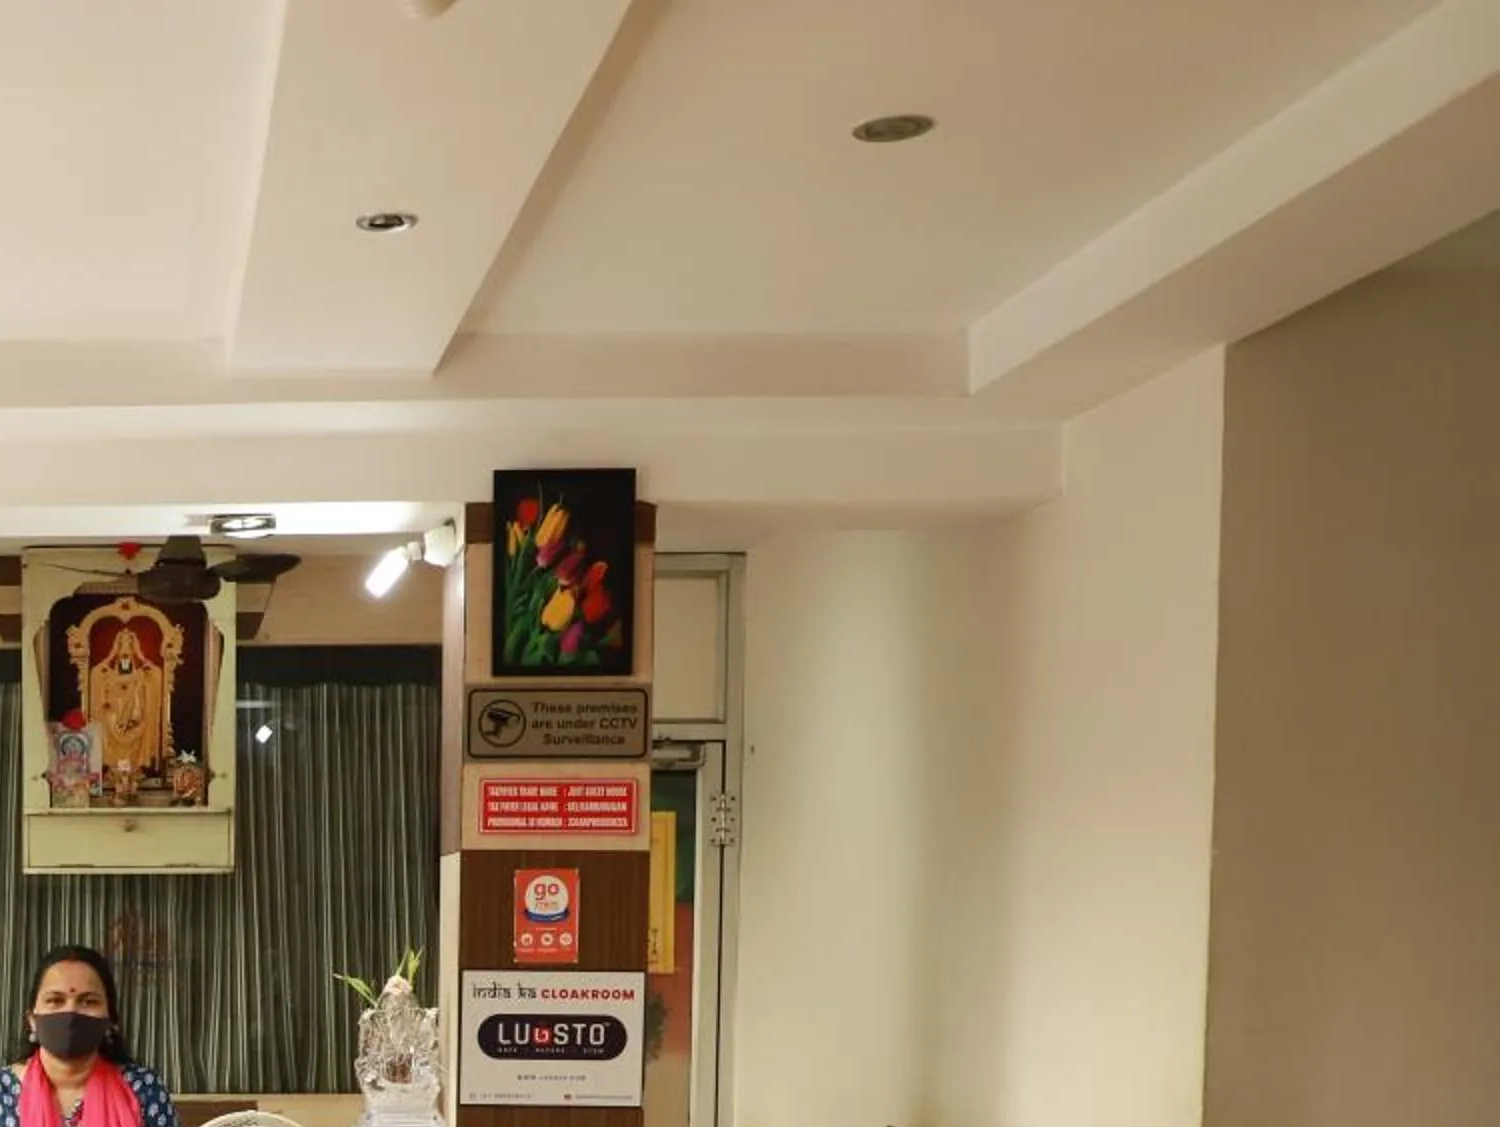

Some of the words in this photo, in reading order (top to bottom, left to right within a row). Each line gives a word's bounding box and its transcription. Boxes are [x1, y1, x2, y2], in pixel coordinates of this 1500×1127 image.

[531, 702, 573, 714] These
[576, 702, 638, 717] premises
[531, 719, 551, 729] are
[556, 717, 596, 729] under
[599, 717, 638, 729] CCTV
[542, 733, 626, 746] Surveillance
[534, 882, 559, 901] go
[541, 988, 636, 1001] CLOAKROOM
